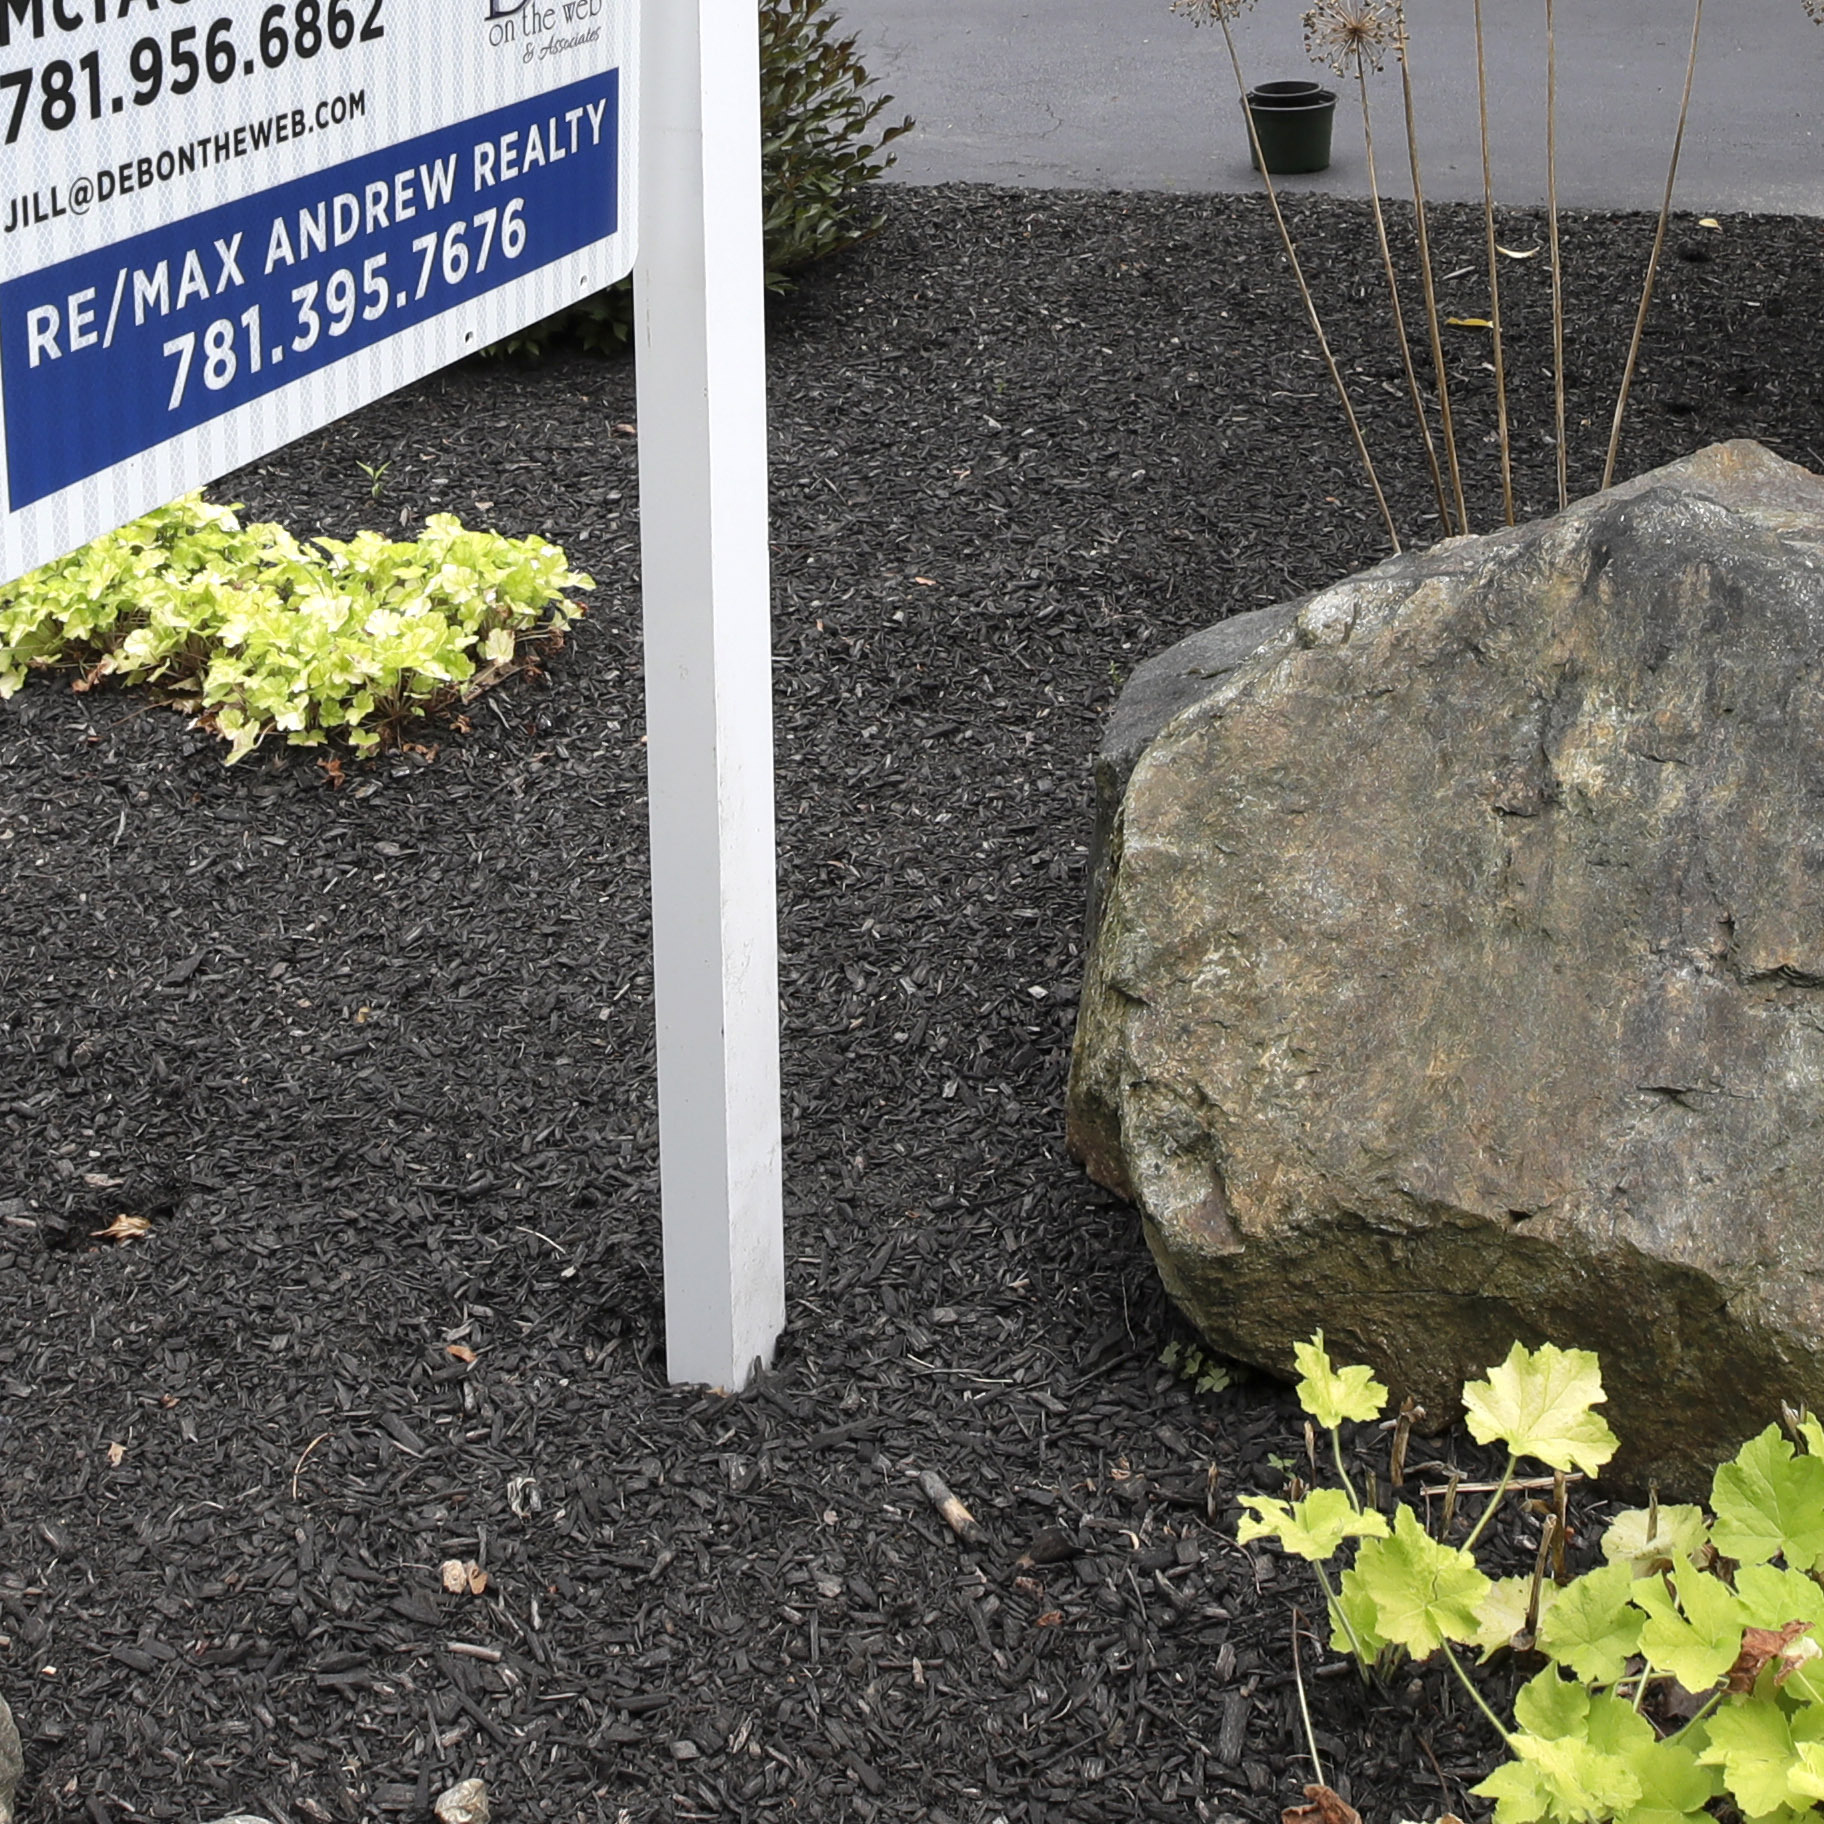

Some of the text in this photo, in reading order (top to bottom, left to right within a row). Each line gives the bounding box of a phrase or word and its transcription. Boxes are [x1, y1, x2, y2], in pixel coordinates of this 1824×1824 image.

[489, 19, 515, 47] on
[522, 0, 557, 37] the
[522, 26, 602, 64] & Associates
[4, 89, 366, 234] JILL@DEBONTHEWEB.COM
[26, 98, 608, 369] RE/MAX ANDREW REALTY
[162, 197, 528, 412] 781.395.7676
